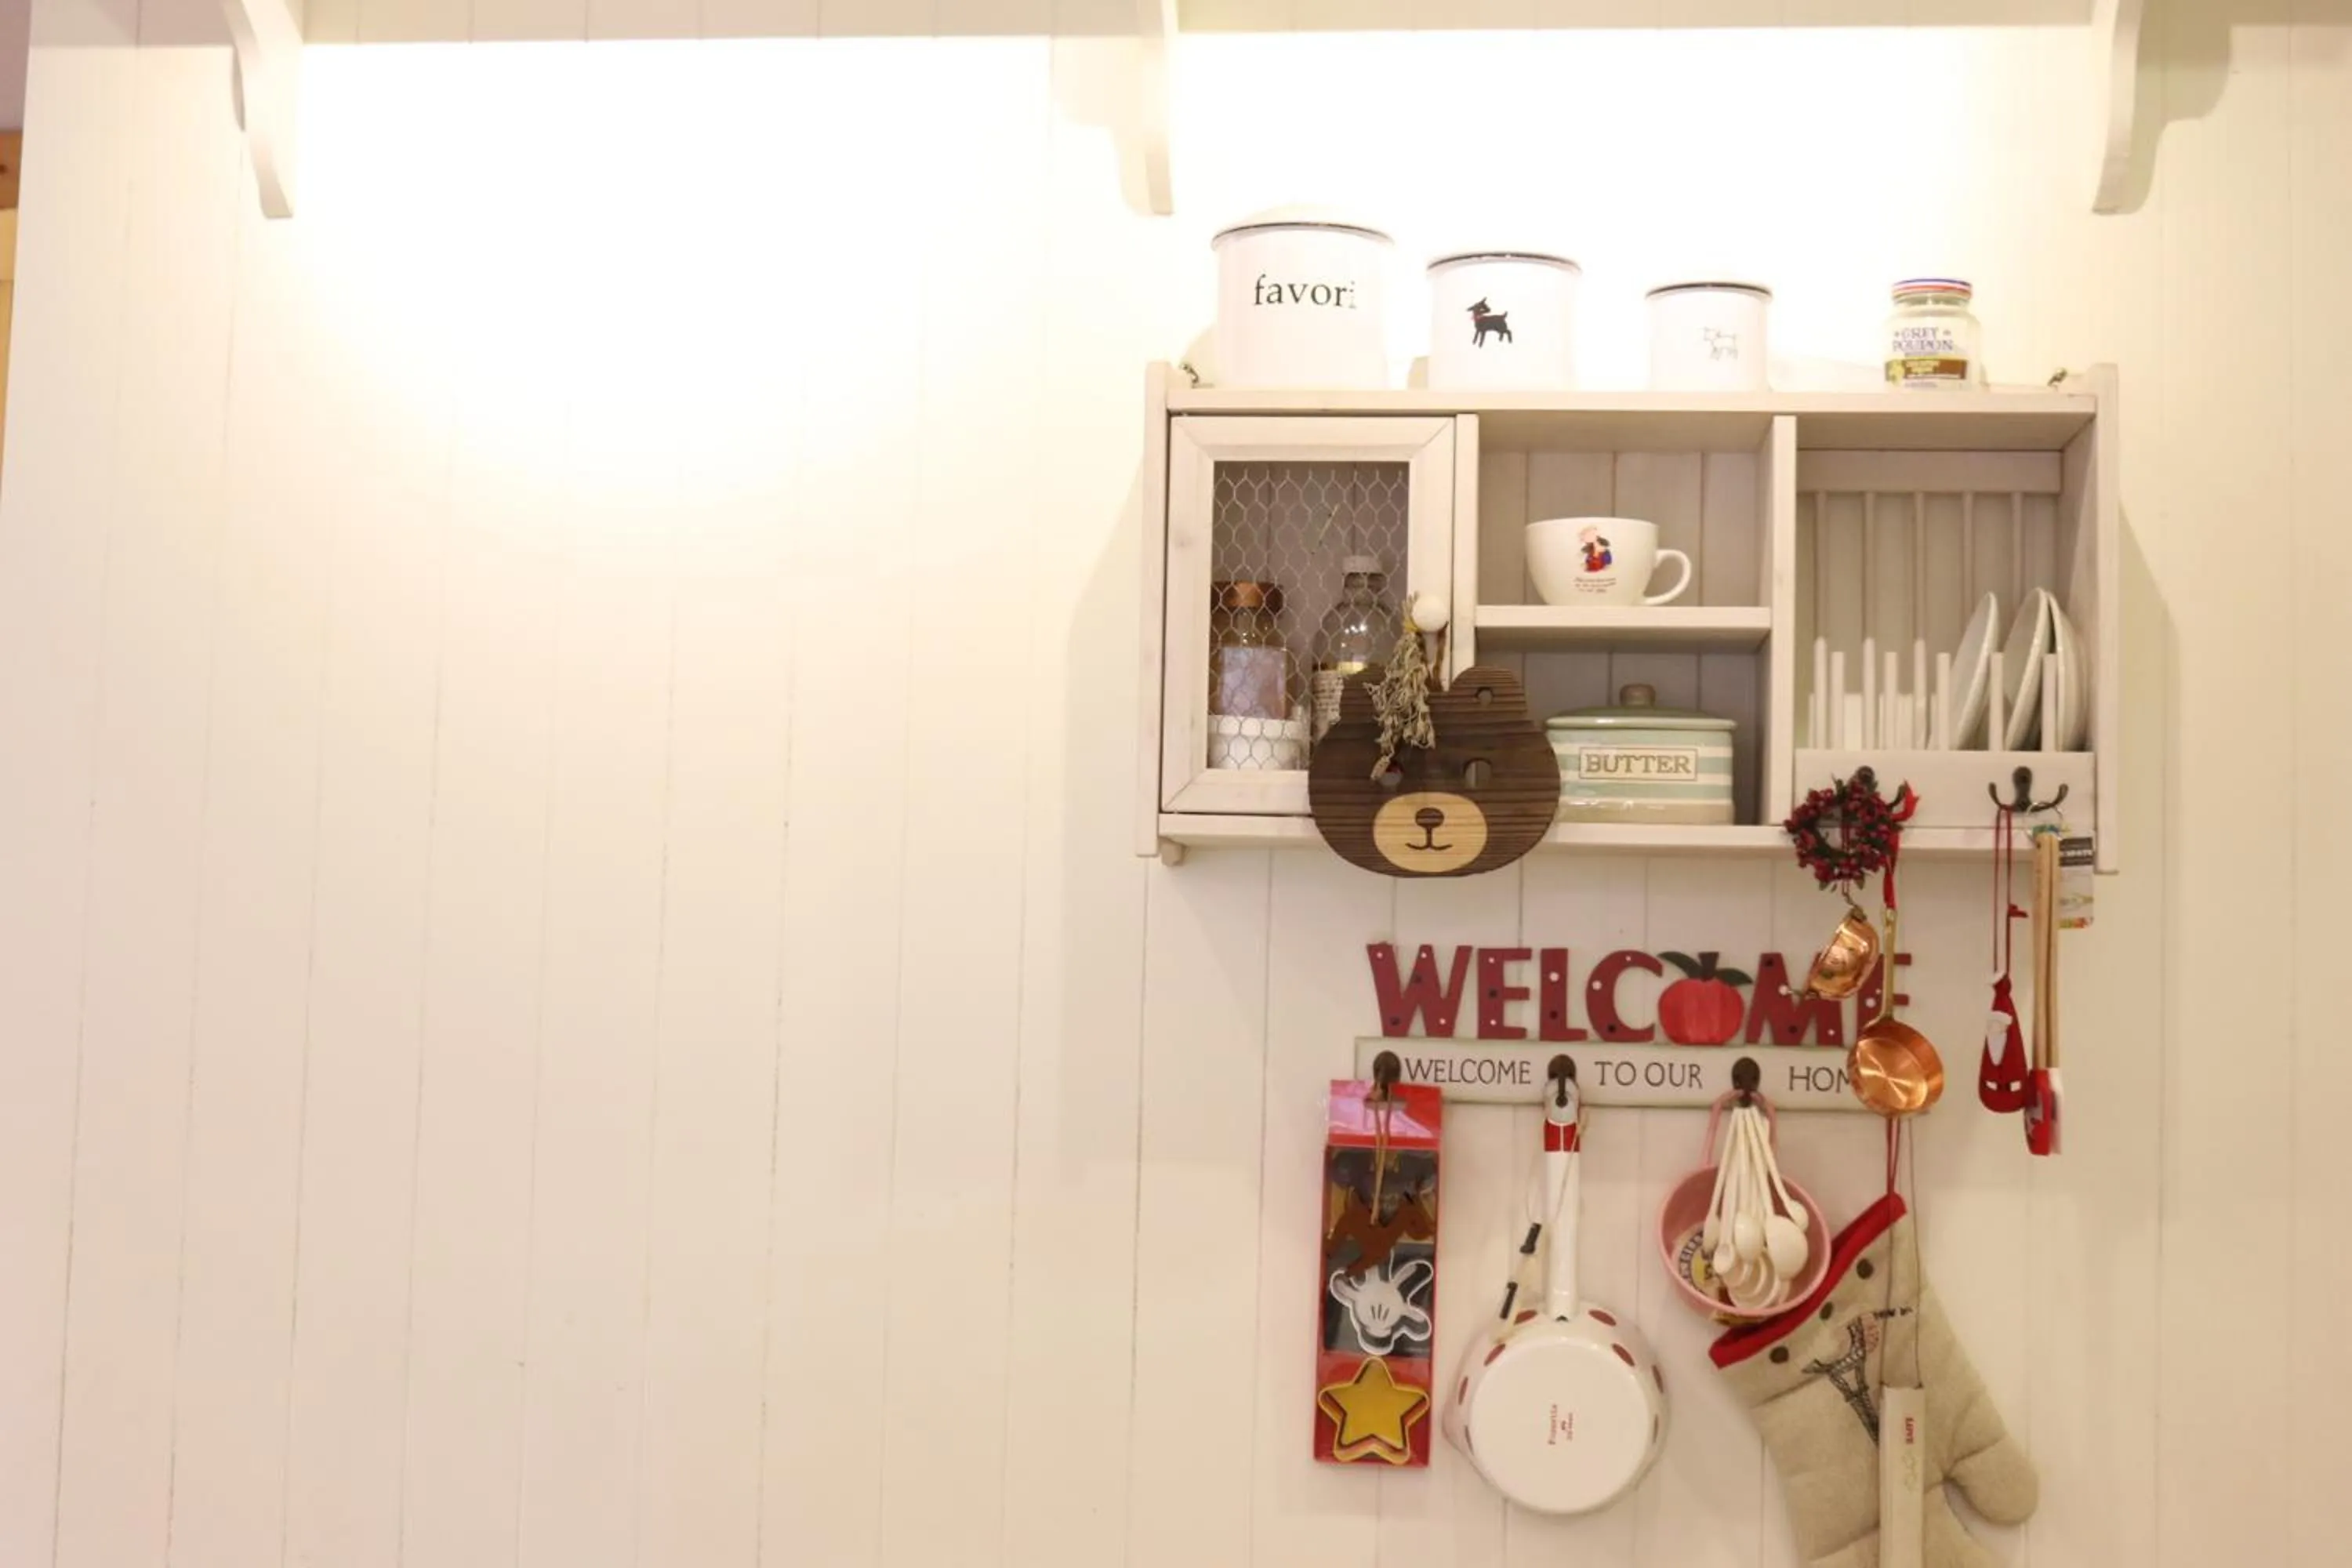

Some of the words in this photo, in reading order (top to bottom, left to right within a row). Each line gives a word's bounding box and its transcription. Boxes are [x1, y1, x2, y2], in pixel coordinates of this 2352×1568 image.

[1585, 753, 1691, 774] BUTTER
[1404, 1058, 1531, 1085] WELCOME
[1595, 1060, 1637, 1087] TO
[1644, 1062, 1703, 1089] OUR
